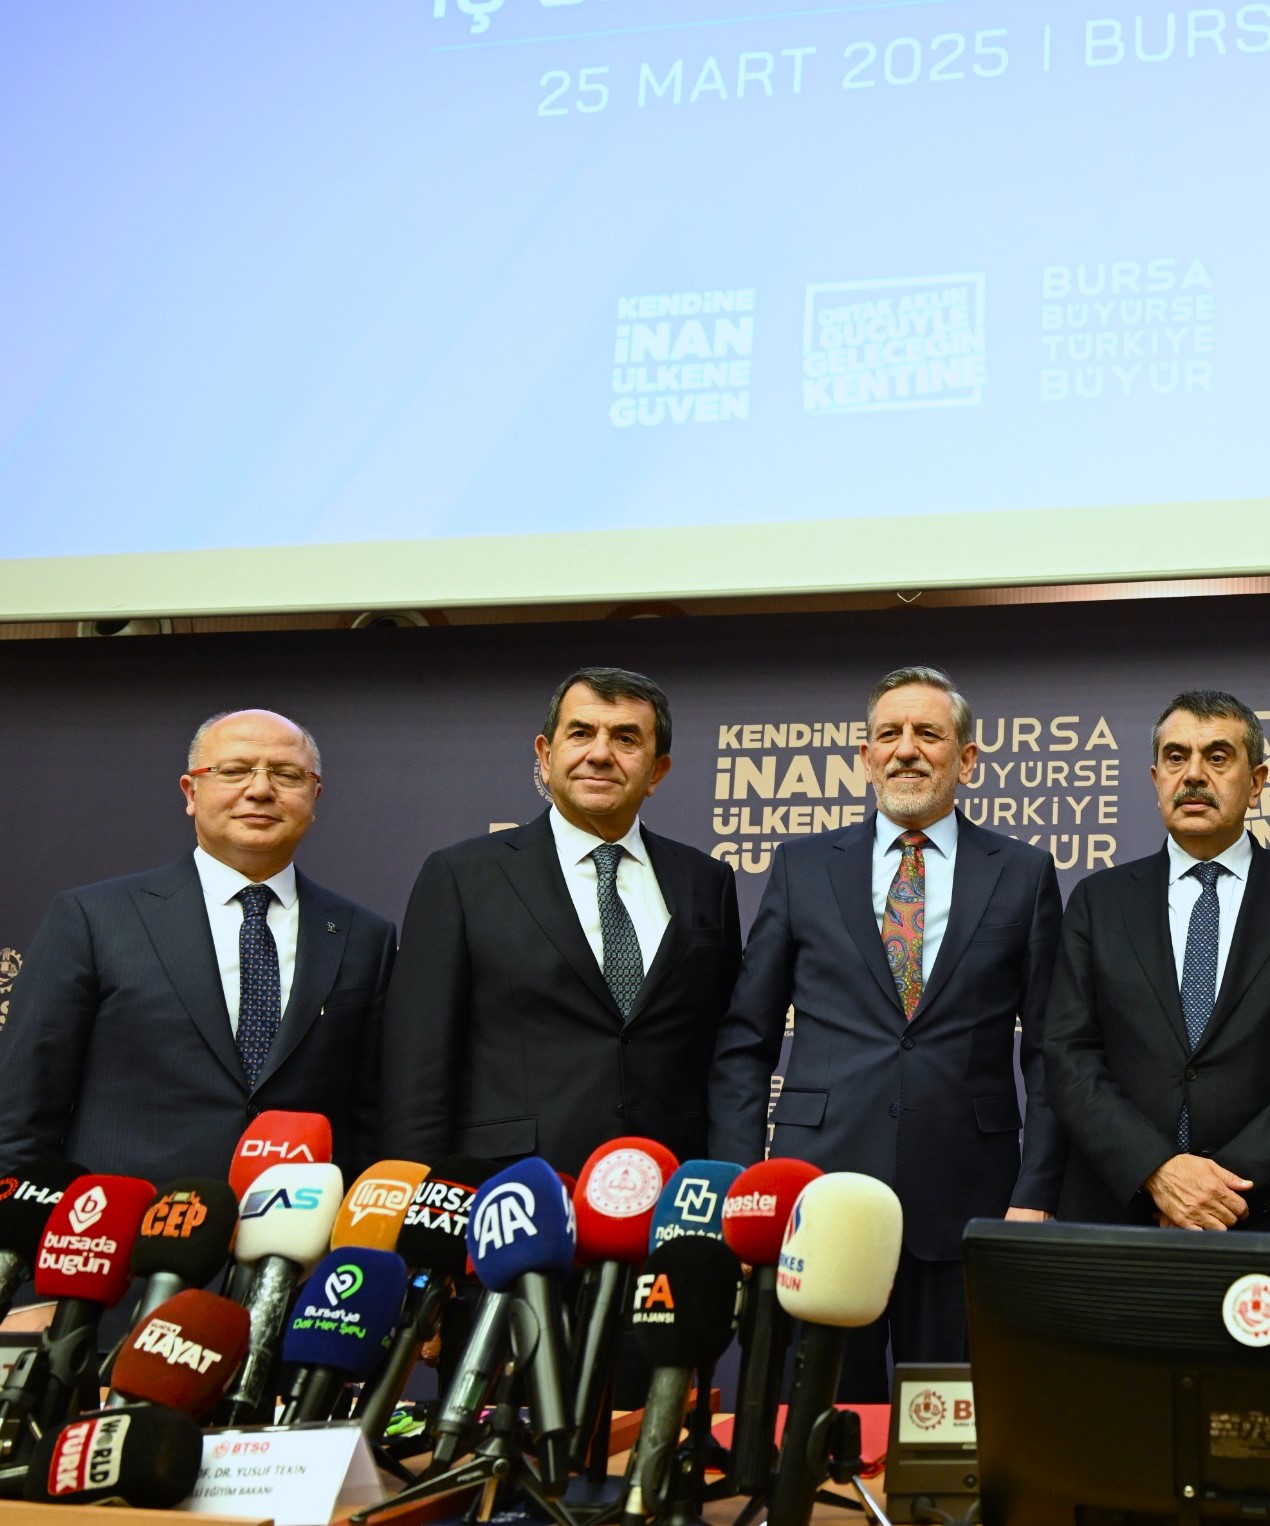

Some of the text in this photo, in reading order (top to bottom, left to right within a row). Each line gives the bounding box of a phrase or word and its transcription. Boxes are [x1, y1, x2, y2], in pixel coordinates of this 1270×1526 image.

[537, 66, 610, 117] 25
[637, 47, 817, 107] MART
[842, 28, 1009, 89] 2025
[1042, 257, 1213, 299] BURSA
[975, 715, 1119, 753] URSA
[965, 759, 1119, 789] ÜYÜRSE
[954, 795, 1119, 826] ÜRKİYE
[241, 1139, 314, 1162] DHA
[411, 1182, 476, 1213] URSA
[44, 1231, 117, 1254] bursada
[38, 1248, 111, 1276] bugün
[133, 1327, 222, 1374] HAYAT
[231, 1441, 270, 1455] BTSO
